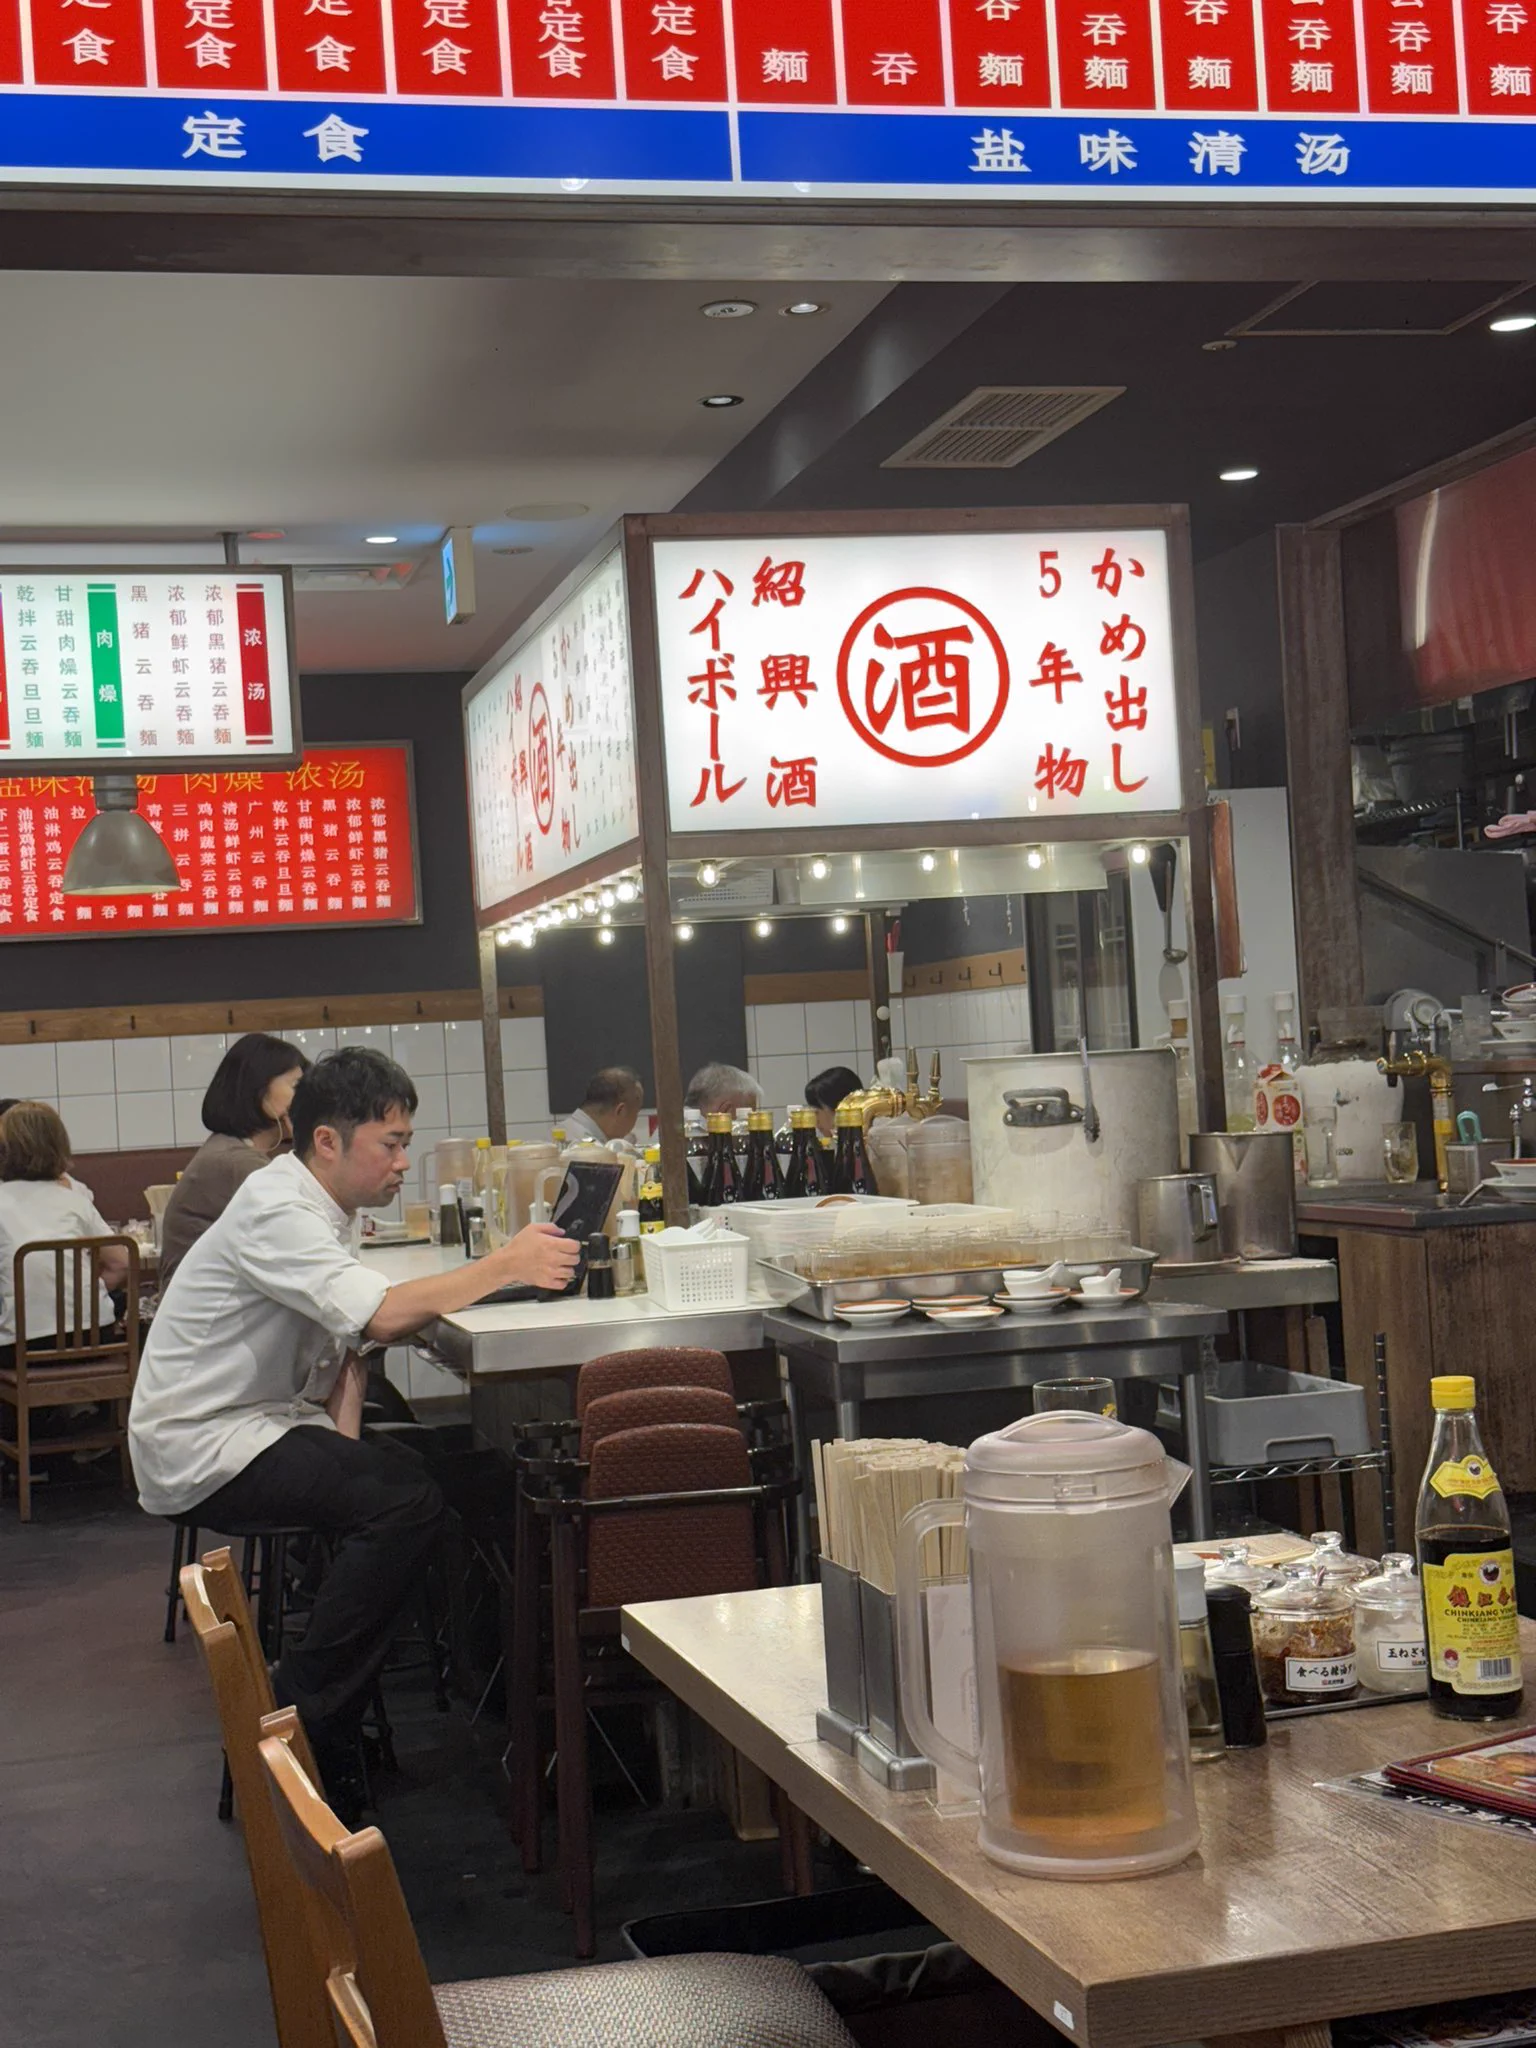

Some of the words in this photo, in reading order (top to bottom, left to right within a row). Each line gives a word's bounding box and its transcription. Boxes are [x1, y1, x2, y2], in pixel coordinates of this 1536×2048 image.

[539, 0, 586, 78] 定食
[651, 0, 698, 81] 定食
[182, 110, 369, 162] 定食
[969, 127, 1351, 176] 盐味清汤
[95, 628, 119, 704] 肉燥
[243, 627, 267, 702] 浓汤
[678, 567, 748, 808] ハイボール
[751, 557, 817, 808] 紹興酒
[864, 622, 975, 736] 酒
[1029, 550, 1088, 799] 5年物
[1091, 546, 1148, 793] かめ出し
[286, 760, 367, 793] 浓汤
[1444, 1607, 1499, 1618] CHINKIANG
